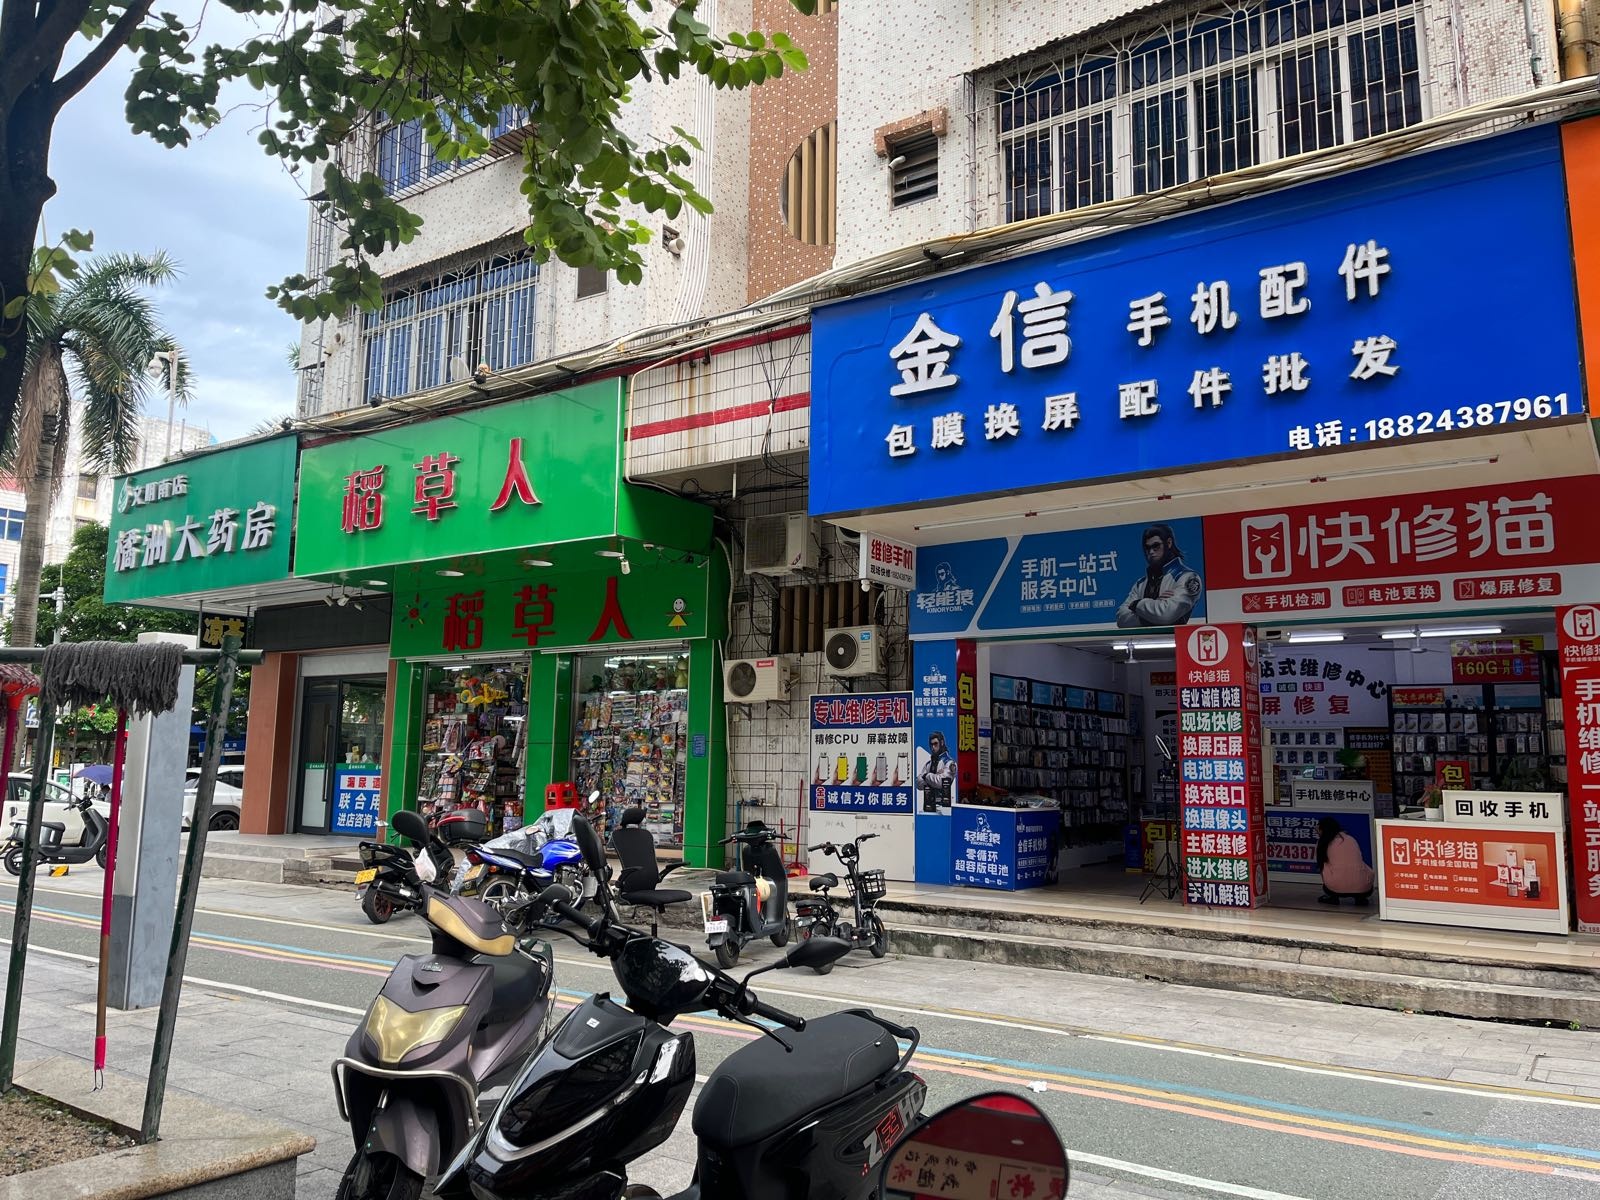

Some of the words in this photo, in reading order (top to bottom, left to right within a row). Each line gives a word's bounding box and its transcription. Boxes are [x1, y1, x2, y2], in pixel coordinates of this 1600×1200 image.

[889, 281, 1075, 396] 金信
[1126, 240, 1391, 347] 手机配件
[1289, 393, 1568, 450] 电话:18824387961
[341, 437, 543, 533] 稻草人
[1297, 492, 1555, 568] 快修猫
[871, 539, 913, 570] 维修手机
[1021, 551, 1117, 578] 手机一站式
[1021, 576, 1097, 600] 服务中心
[1264, 592, 1326, 609] 手机检测
[1368, 584, 1435, 602] 电池更换
[1479, 578, 1554, 596] 爆屏修复
[442, 576, 634, 650] 稻草人
[1189, 670, 1230, 683] 快修猫
[1457, 660, 1497, 675] 160G
[1182, 688, 1200, 708] 专业
[1201, 687, 1220, 708] 诚信
[1221, 687, 1241, 708] 快速
[814, 697, 909, 725] 专业维修手机
[958, 673, 976, 752] 包膜
[1182, 711, 1241, 732] 现场快修
[815, 734, 859, 745] 精修CPU
[867, 732, 908, 745] 屏幕故障
[1183, 735, 1243, 756] 换屏压屏
[1184, 760, 1244, 780] 电池更换
[828, 791, 908, 806] 诚信为你服务
[1185, 784, 1245, 805] 换充电口
[1296, 789, 1371, 802] 手机维修中心
[1185, 808, 1246, 830] 换摄像头
[1456, 800, 1549, 819] 回收手机
[966, 848, 998, 862] 零循环
[1186, 833, 1247, 855] 主板维修
[1413, 839, 1478, 860] 快修猫
[955, 859, 1009, 876] 超容版电池
[1187, 858, 1249, 880] 进水维修
[1188, 882, 1250, 906] 手机解锁
